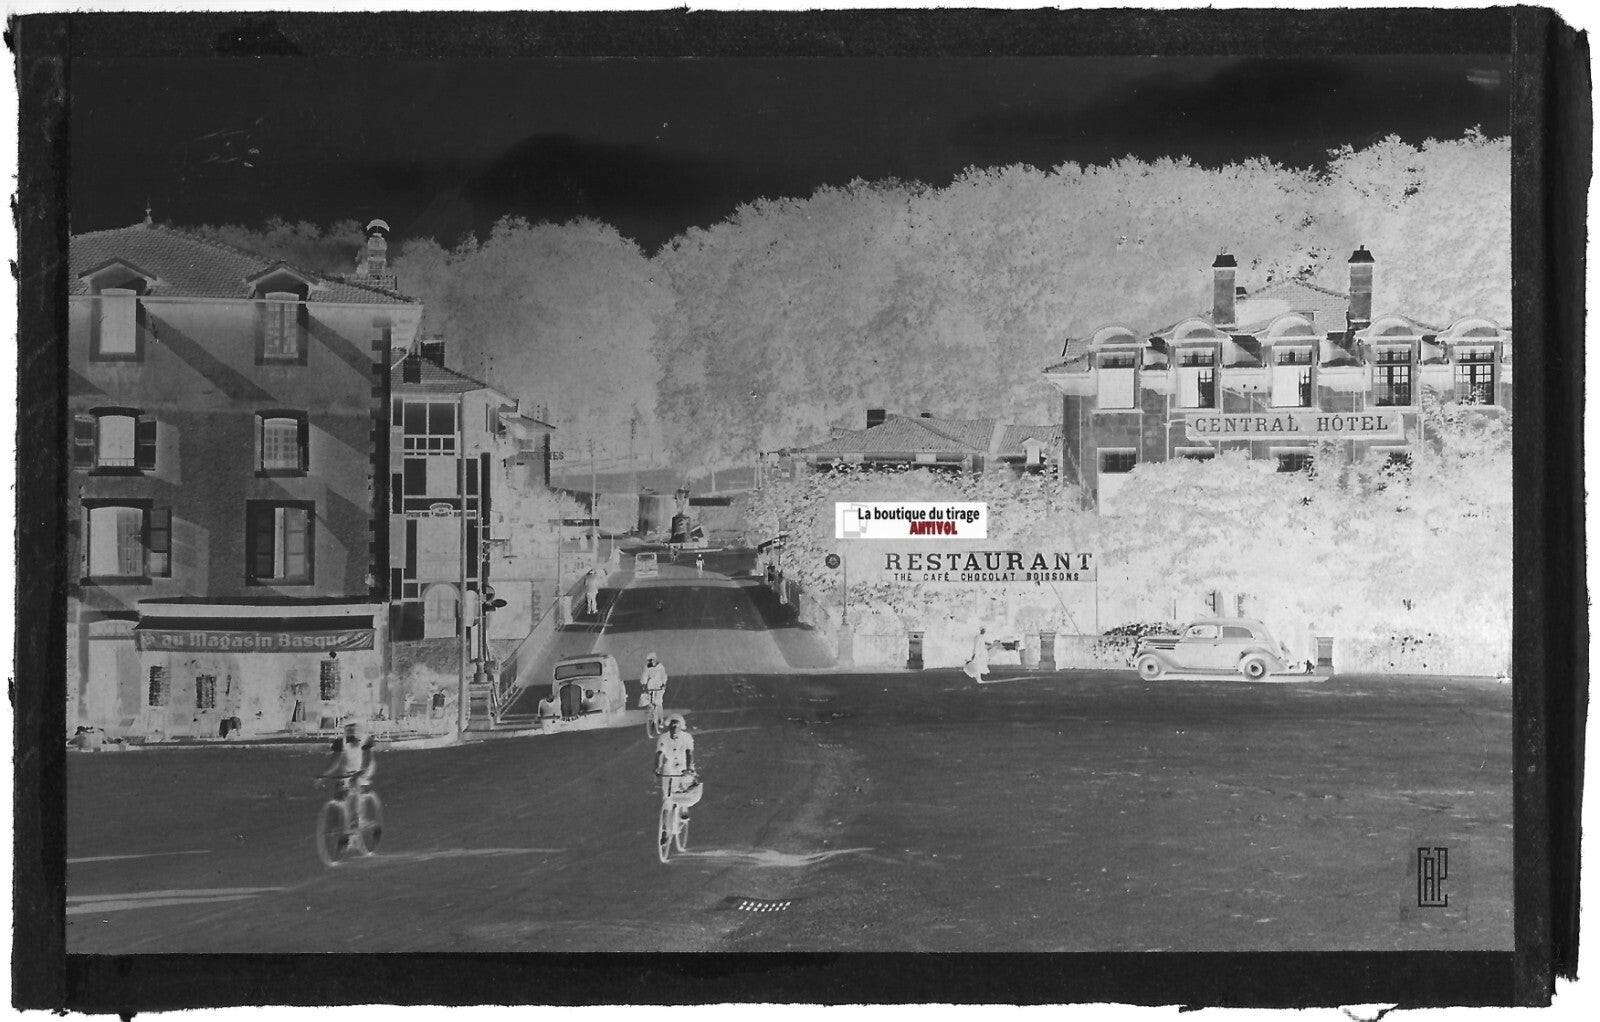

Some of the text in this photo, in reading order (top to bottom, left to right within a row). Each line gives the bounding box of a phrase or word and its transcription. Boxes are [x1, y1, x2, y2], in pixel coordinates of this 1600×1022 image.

[1196, 414, 1388, 432] CENTRAL HÔTEL
[885, 552, 1092, 571] RESTAURANT
[923, 572, 950, 582] CAFÉ
[961, 573, 1015, 582] CHOCOLAT
[1026, 573, 1079, 582] BOISSONS
[189, 632, 272, 650] Magasin
